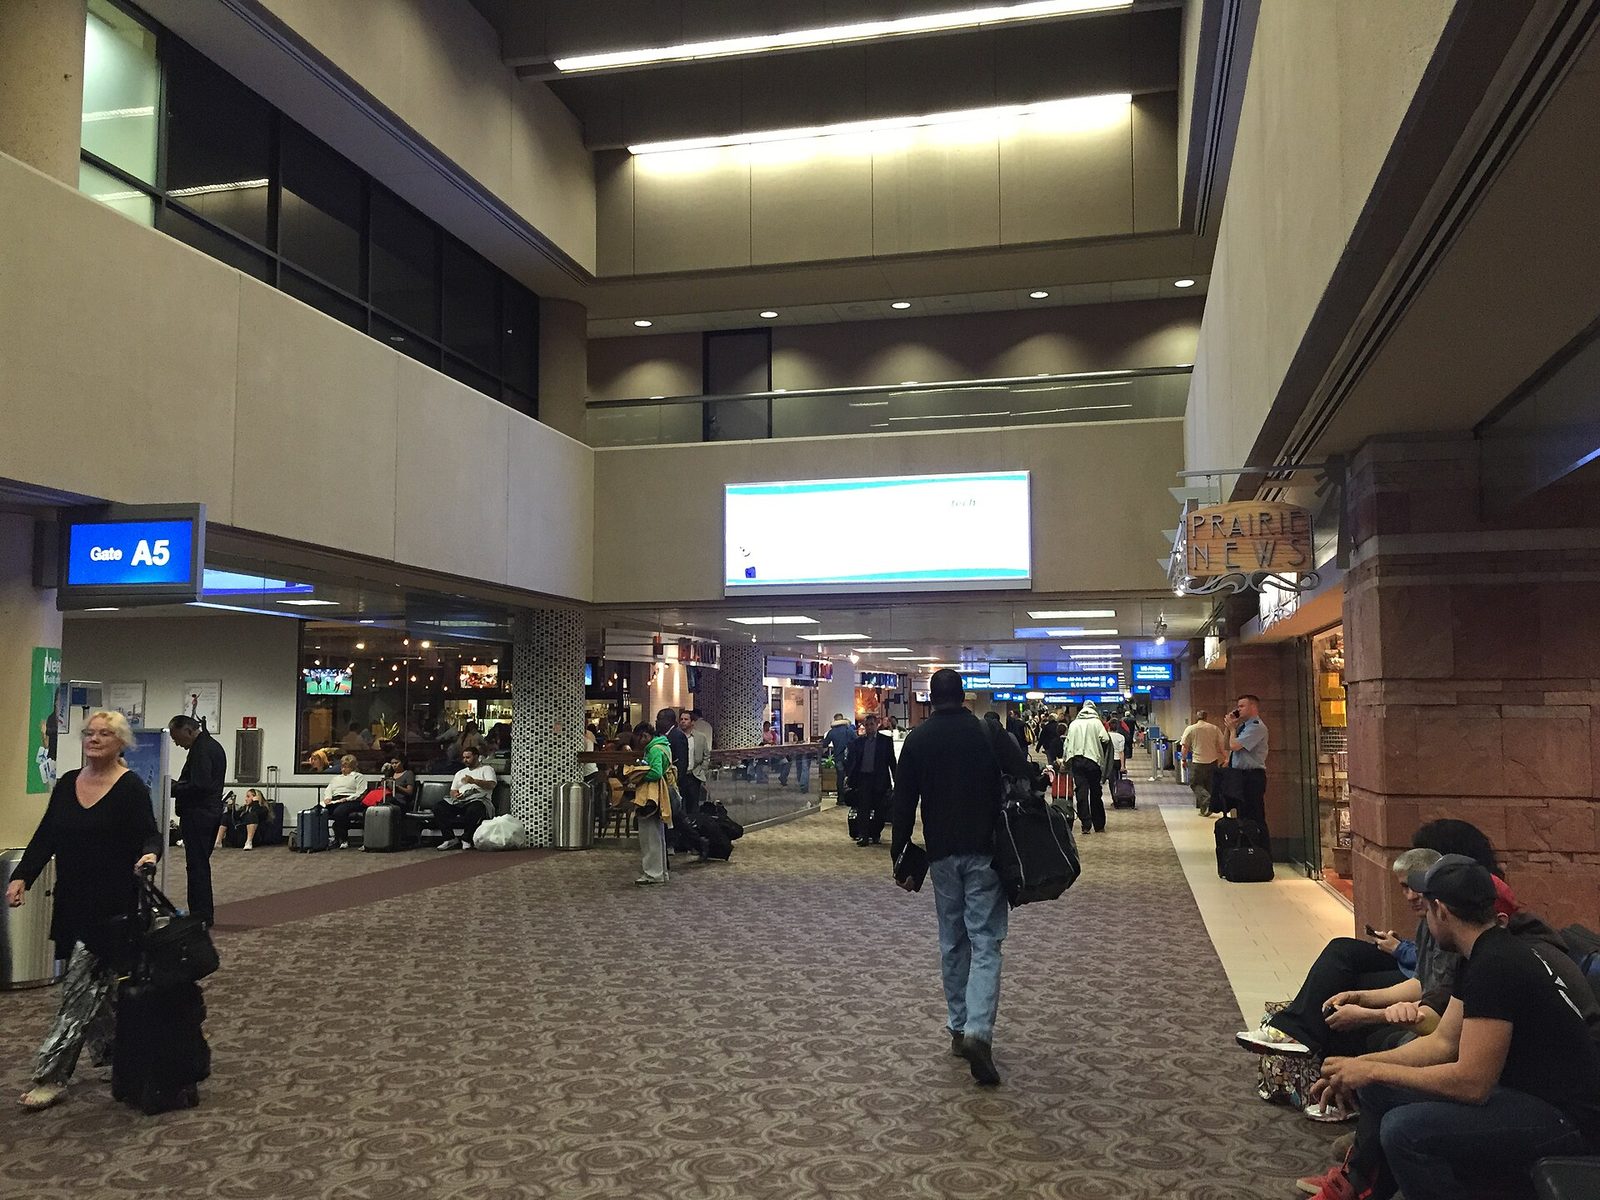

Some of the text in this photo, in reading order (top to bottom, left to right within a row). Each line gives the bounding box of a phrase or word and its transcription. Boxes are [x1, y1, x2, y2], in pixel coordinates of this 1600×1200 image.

[1192, 511, 1302, 538] PRAIRIE
[90, 540, 170, 566] Gate A5
[1193, 539, 1307, 570] NEWS
